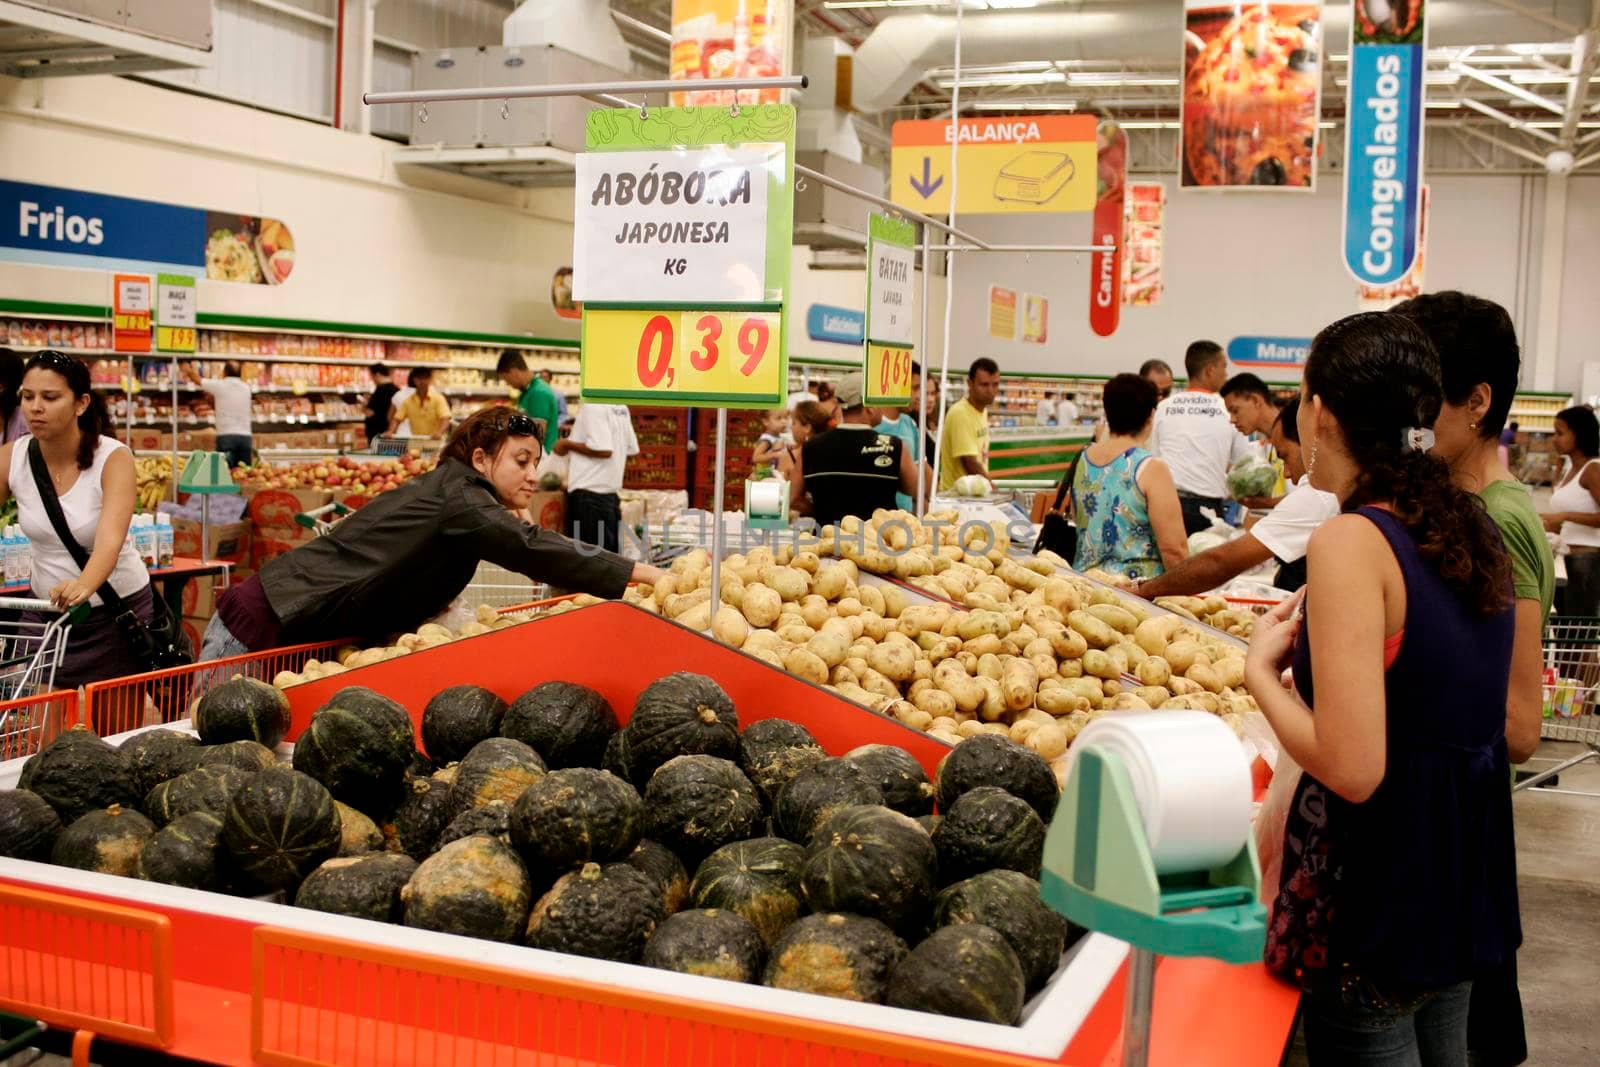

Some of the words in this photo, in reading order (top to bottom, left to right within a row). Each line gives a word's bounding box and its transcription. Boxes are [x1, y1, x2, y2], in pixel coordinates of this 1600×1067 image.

[945, 121, 1041, 145] BALANÇA
[1362, 54, 1404, 276] Congelados
[19, 201, 104, 246] Frios
[615, 221, 730, 244] JAPONESA
[664, 258, 687, 276] KG
[879, 257, 908, 284] BATATA
